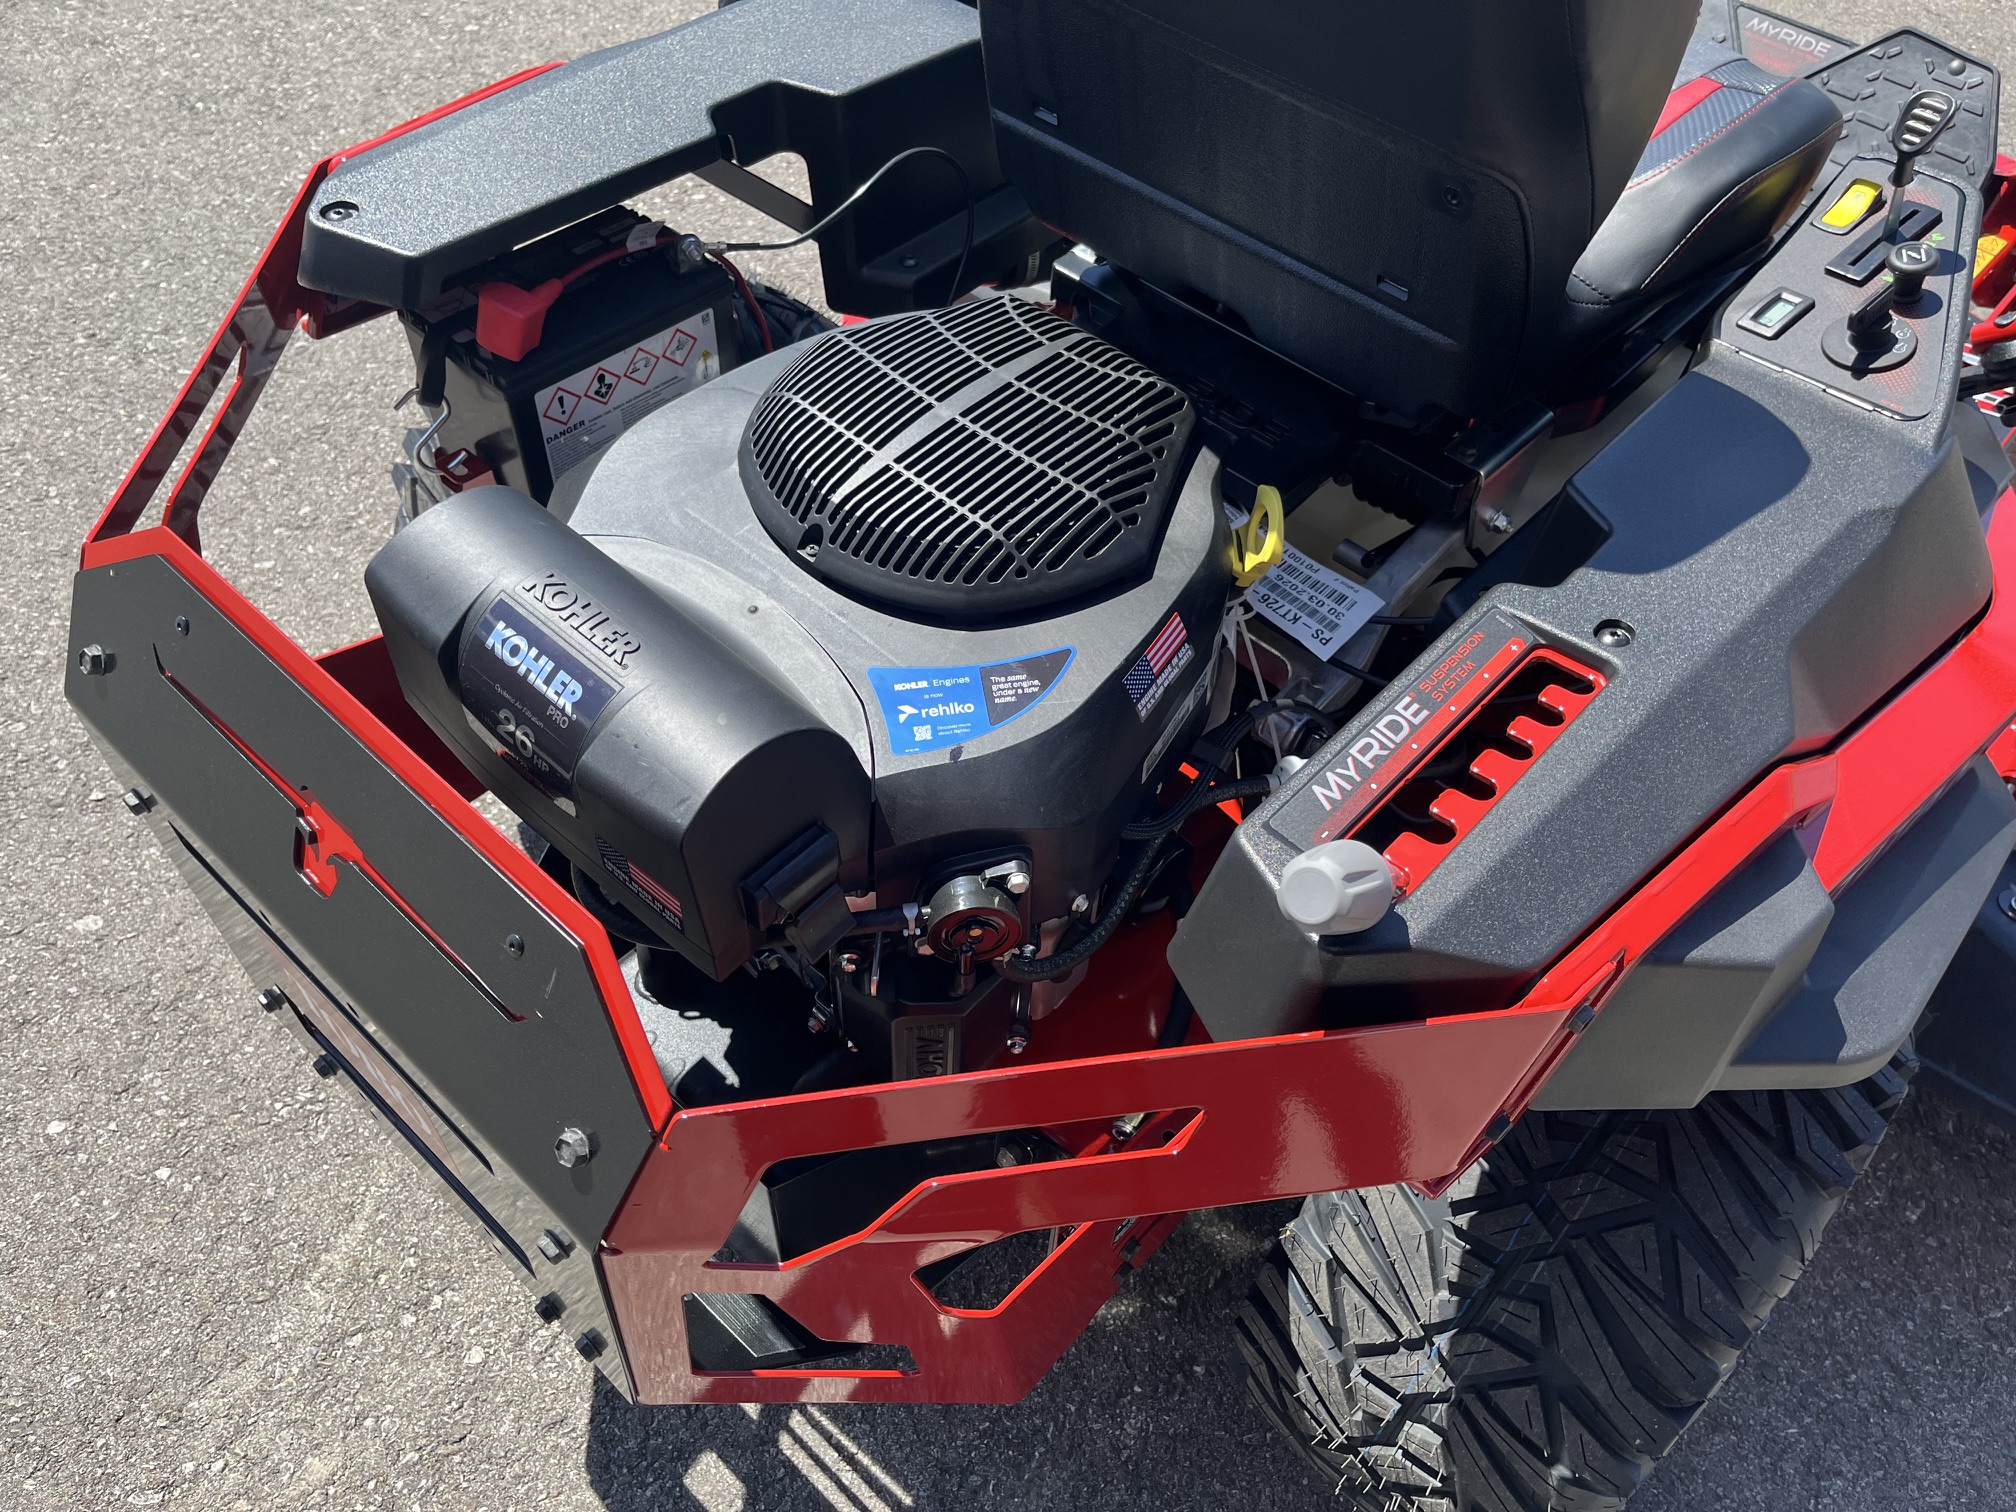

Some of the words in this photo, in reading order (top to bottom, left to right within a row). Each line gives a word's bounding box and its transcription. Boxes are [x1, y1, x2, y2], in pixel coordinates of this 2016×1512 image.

[546, 420, 586, 445] DANGER
[1283, 547, 1320, 574] P01001
[1273, 573, 1346, 621] 30.03.2026
[521, 572, 641, 668] KOHLER
[1311, 628, 1333, 646] PS
[484, 620, 583, 715] KOHLER
[1154, 686, 1165, 700] AND
[1163, 667, 1179, 688] GLOBAL
[1178, 649, 1192, 668] PARTS
[1419, 631, 1486, 693] SUSPENSION
[893, 680, 929, 691] KOHLER
[932, 676, 970, 687] Engines
[991, 683, 1012, 691] great
[1012, 679, 1041, 688] engine,
[1006, 674, 1027, 682] same
[1137, 683, 1158, 711] ENGINE
[1156, 664, 1173, 686] MADE
[1171, 655, 1179, 667] IN
[1177, 642, 1190, 658] USA
[1431, 660, 1476, 702] SYSTEM
[992, 688, 1016, 697] under
[1024, 686, 1040, 694] new
[994, 696, 1018, 704] name.
[546, 704, 569, 729] PRO
[921, 701, 975, 718] rehlko
[496, 708, 535, 758] 26
[533, 754, 550, 772] HP
[603, 857, 630, 883] ENGINE
[631, 880, 653, 901] MADE
[665, 908, 681, 925] USA
